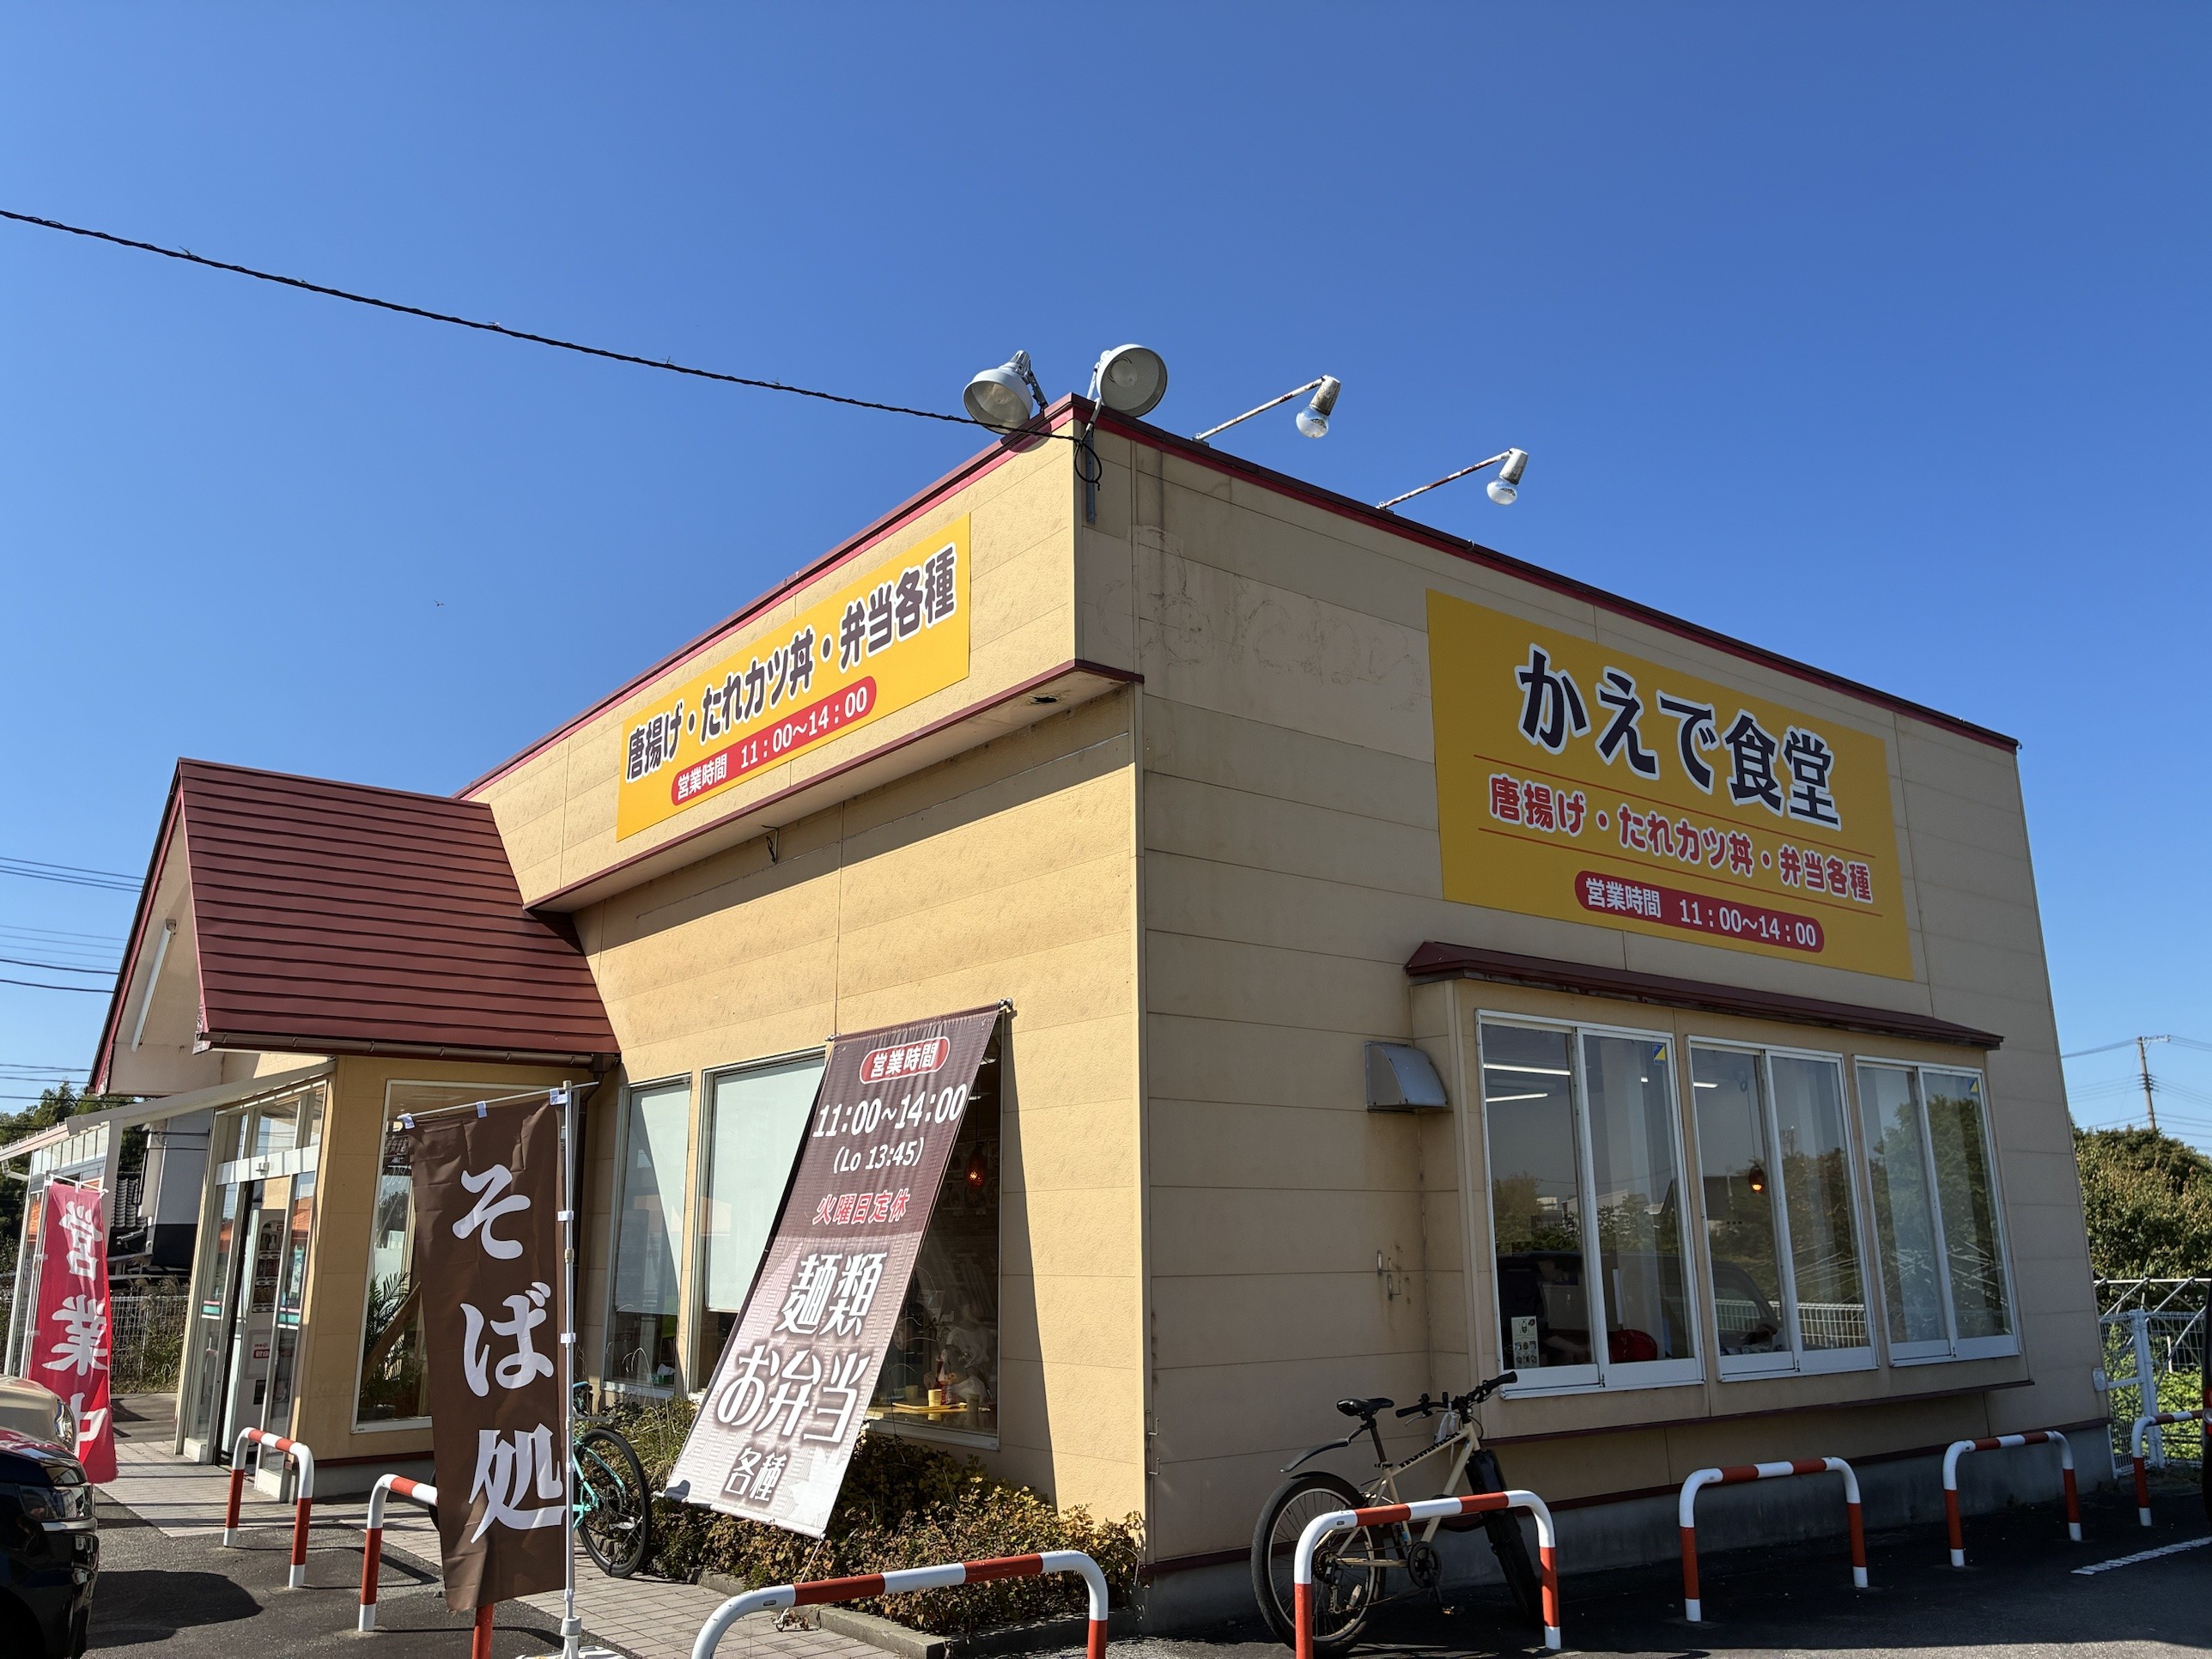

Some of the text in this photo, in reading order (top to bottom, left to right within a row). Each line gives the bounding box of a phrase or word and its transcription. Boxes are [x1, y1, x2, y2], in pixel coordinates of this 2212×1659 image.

[625, 542, 957, 783] 唐揚げ・たれカツ丼・弁当各種
[1515, 643, 1841, 830] かえで食堂
[678, 753, 728, 800] 営業時間
[1488, 774, 1873, 904] 唐揚げ・たれカツ丼・弁当各種
[1586, 878, 1662, 918] 営業時間
[870, 1042, 940, 1079] 営業時間
[812, 1083, 968, 1138] 11:00~14:00
[834, 1137, 925, 1174] (Lo 13:45)
[812, 1188, 910, 1225] 火曜日定休
[775, 1250, 888, 1337] 麺類
[452, 1164, 565, 1544] そば処
[715, 1344, 873, 1443] お弁当
[725, 1447, 787, 1504] 各種
